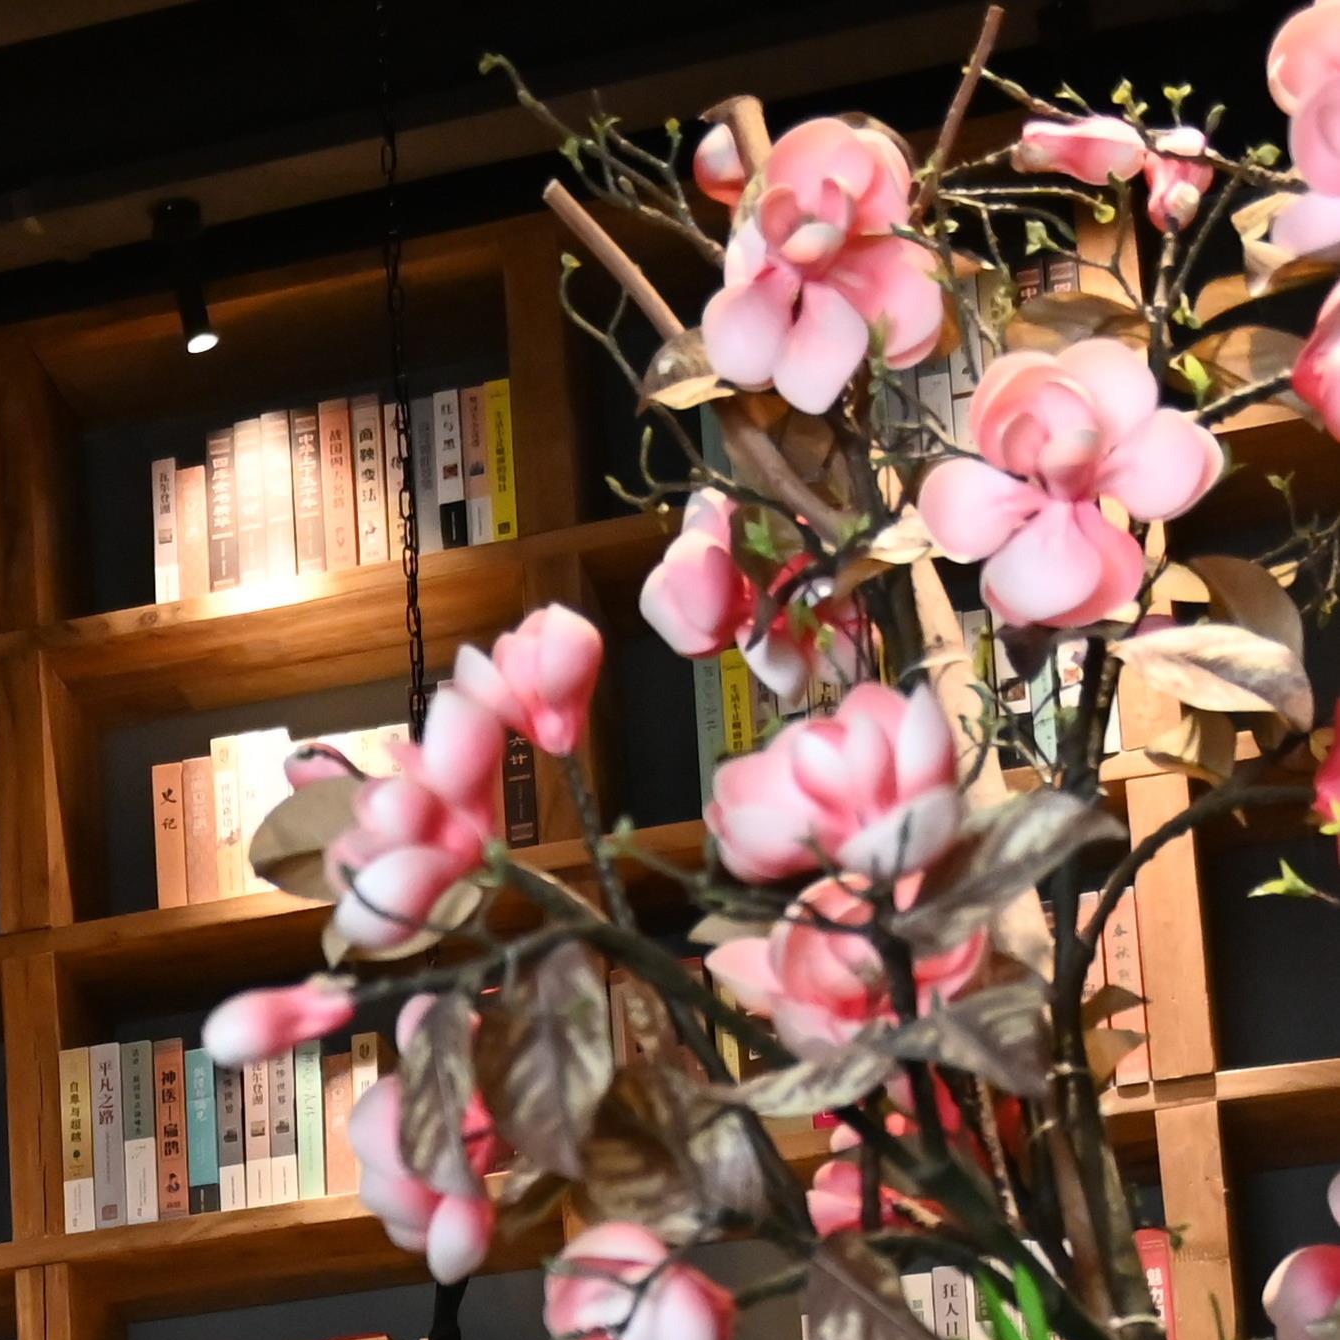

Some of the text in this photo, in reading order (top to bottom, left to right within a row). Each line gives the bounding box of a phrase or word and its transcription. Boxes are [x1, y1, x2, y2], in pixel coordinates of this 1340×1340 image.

[359, 427, 376, 503] 商鞅变法
[69, 1081, 82, 1143] 自卑与超越
[98, 1061, 114, 1126] 平凡之路
